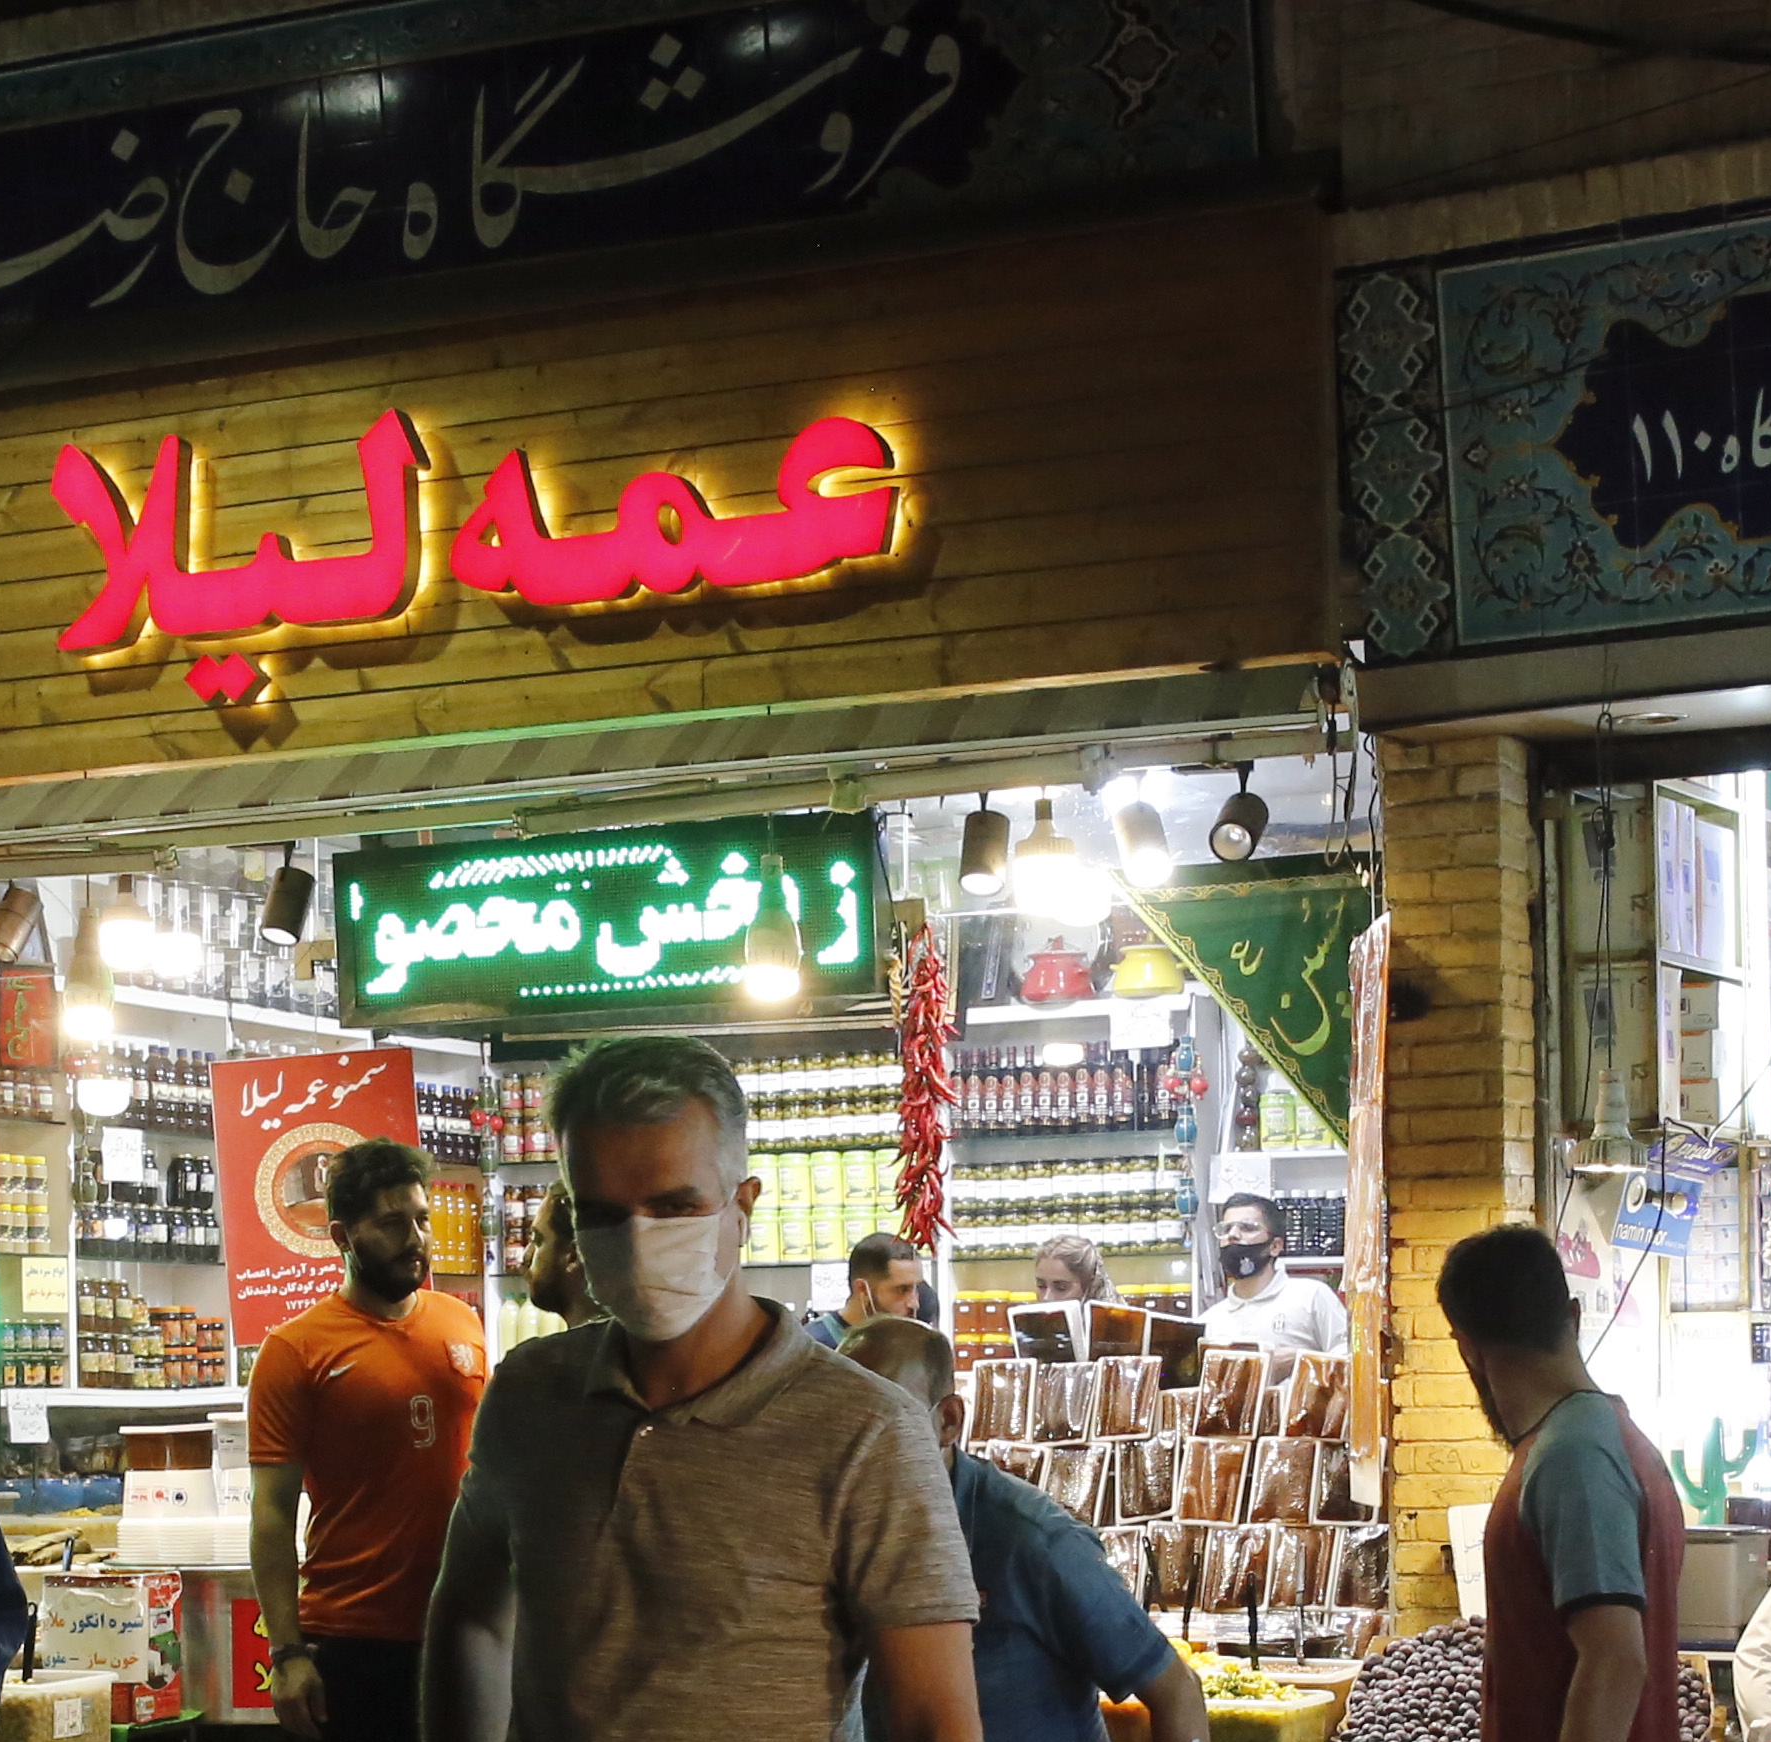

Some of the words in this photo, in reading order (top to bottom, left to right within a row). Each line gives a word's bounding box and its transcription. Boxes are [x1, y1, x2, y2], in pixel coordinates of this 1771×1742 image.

[402, 20, 963, 262] فروشگاه
[174, 106, 378, 296] حاج
[451, 415, 910, 608] عمه
[48, 405, 428, 707] لیلا
[328, 1054, 388, 1110] سمنو
[240, 1070, 284, 1131] لیلا
[283, 1078, 329, 1115] عمه
[1615, 1222, 1645, 1242] namin
[236, 1267, 271, 1281] اعصاب
[271, 1262, 308, 1279] آرامش
[309, 1266, 317, 1276] و
[318, 1263, 337, 1276] عمر
[279, 1281, 315, 1296] کودکان
[316, 1279, 338, 1293] برای
[410, 1394, 436, 1449] 9
[69, 1613, 105, 1634] انگور
[110, 1653, 140, 1669] خون
